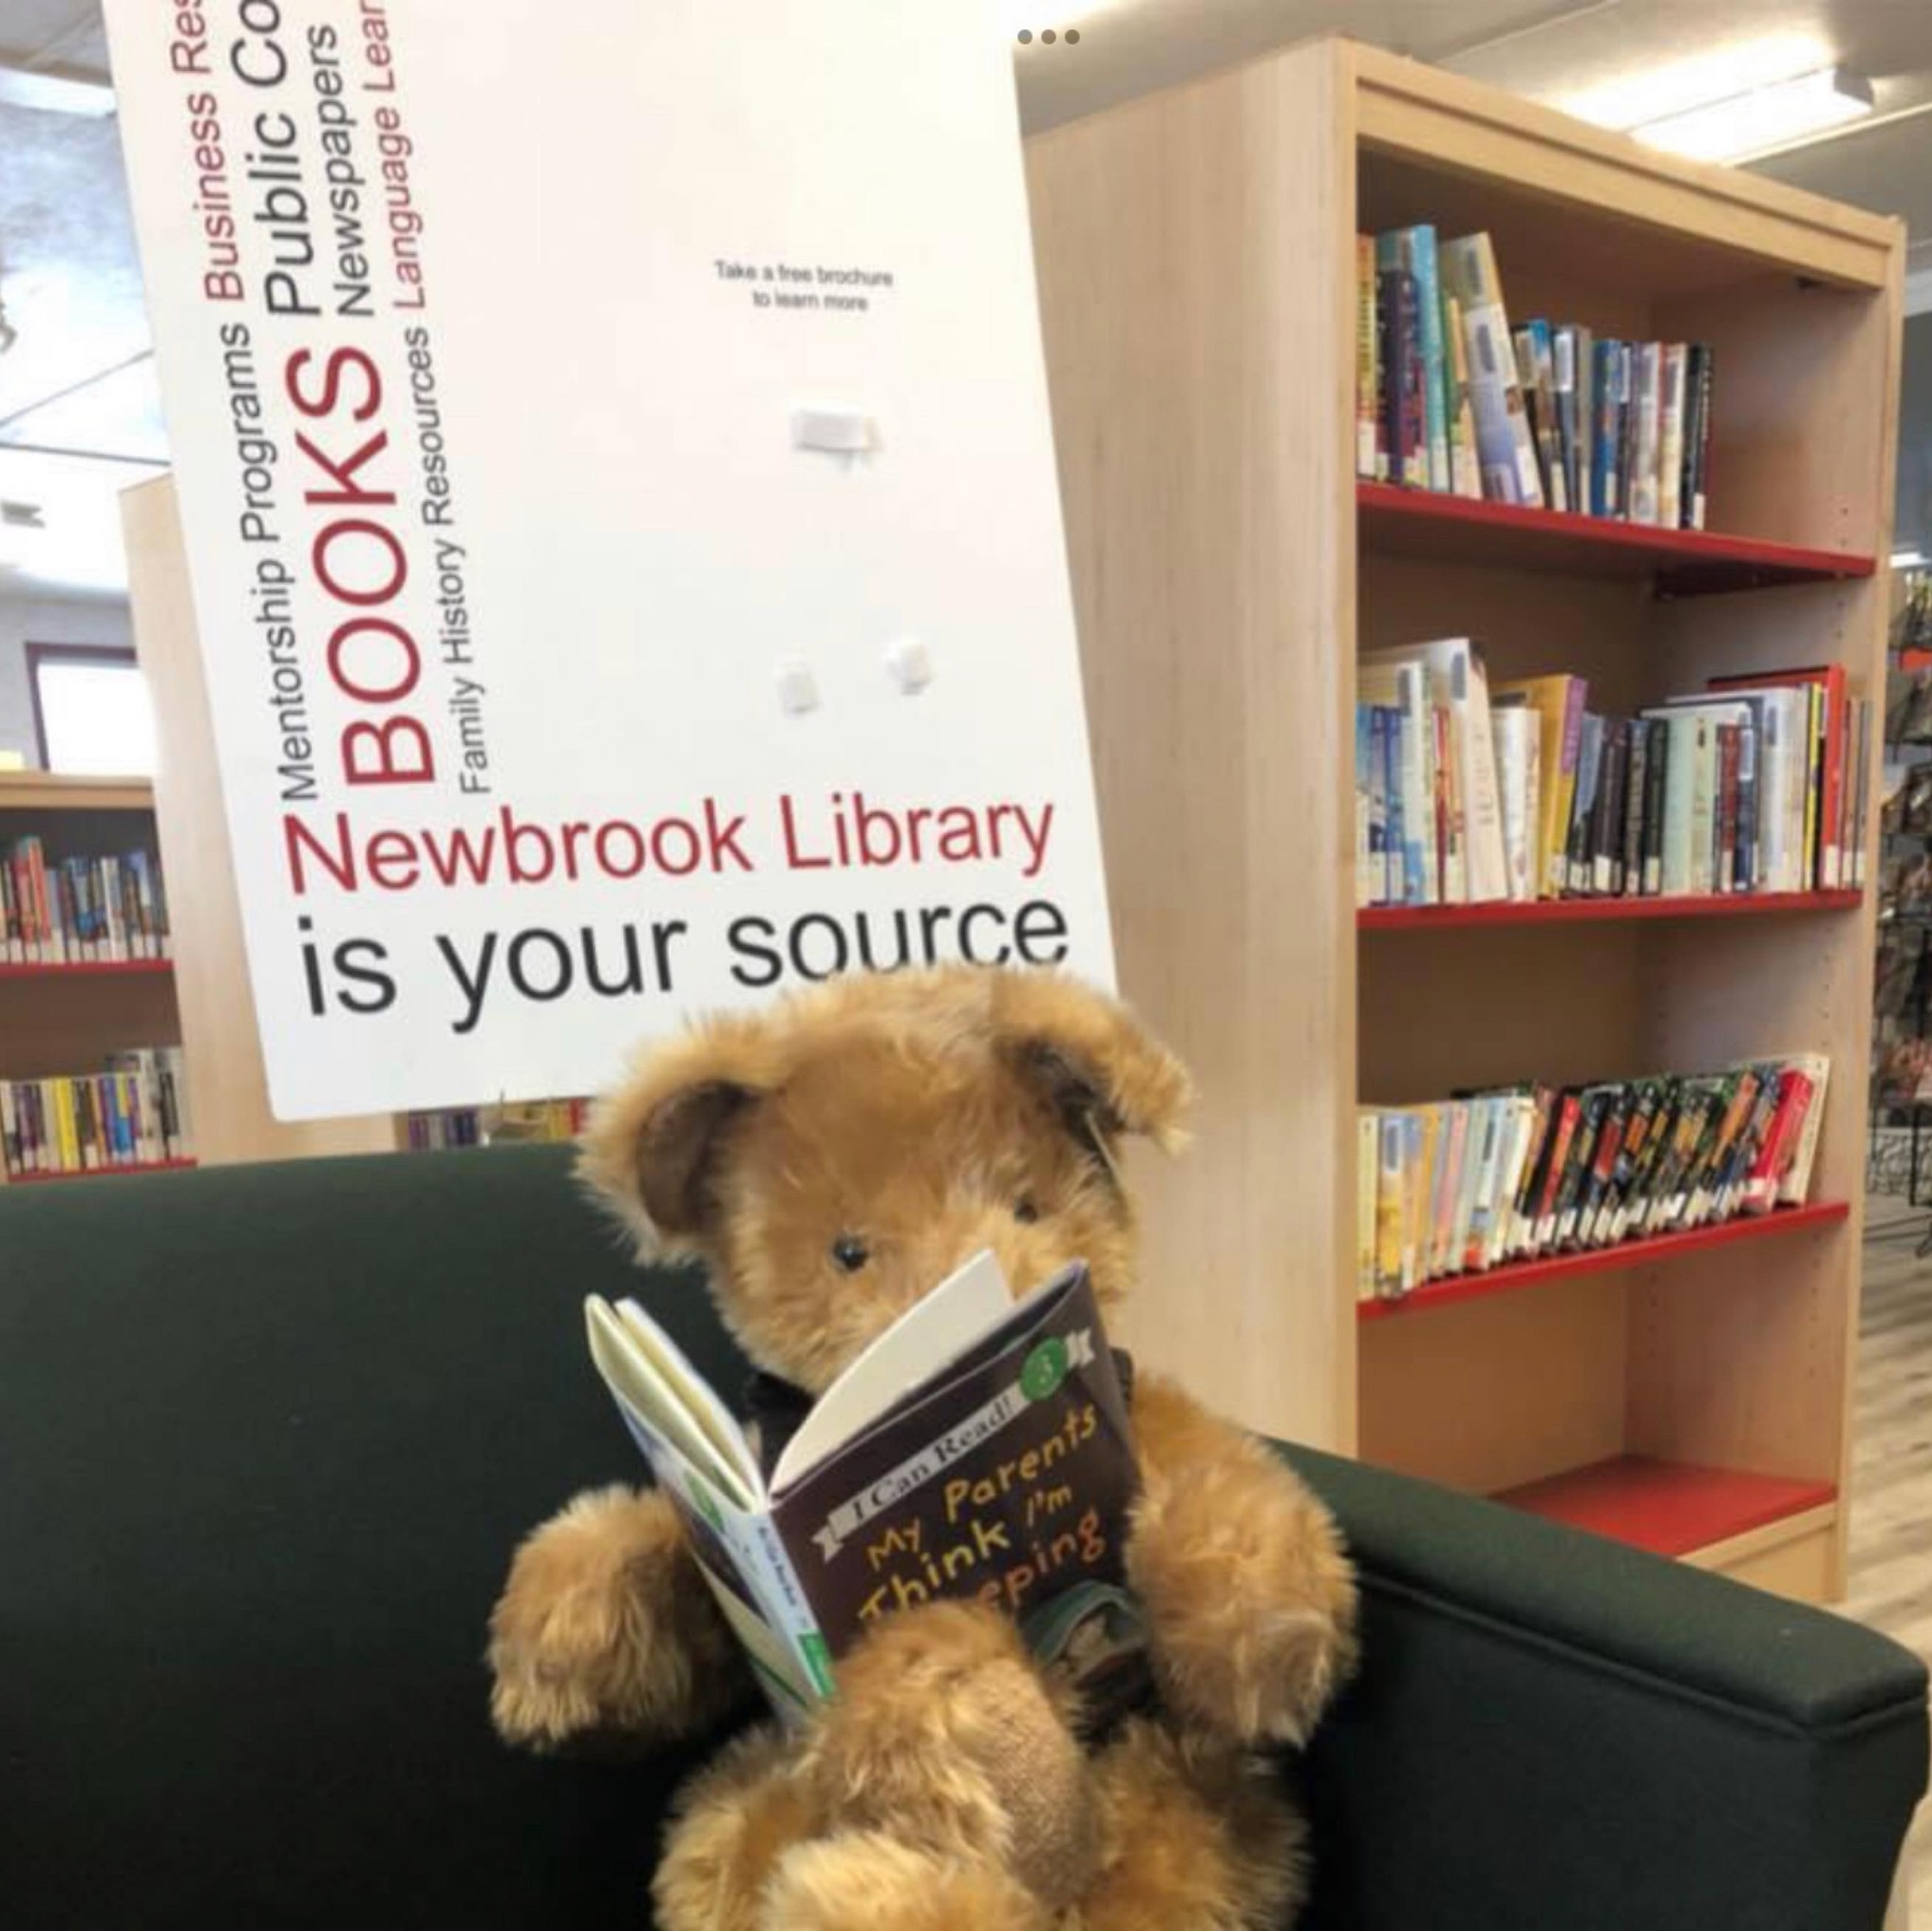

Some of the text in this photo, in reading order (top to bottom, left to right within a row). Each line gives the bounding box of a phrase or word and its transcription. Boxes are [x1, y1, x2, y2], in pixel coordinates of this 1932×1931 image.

[186, 92, 245, 302] Business
[243, 111, 323, 318] Public
[306, 24, 375, 318] Newspapers
[358, 0, 426, 309] Language Lear
[715, 259, 893, 287] Take a free brochure
[752, 291, 868, 311] to learn more
[219, 322, 320, 802] Mentorship Programs
[284, 345, 437, 787] BOOKS
[403, 325, 491, 794] Family History Resources
[282, 791, 1055, 896] Newbrook Library
[296, 898, 1070, 1033] is your source
[853, 1394, 1012, 1520] I Can Read!
[944, 1402, 1098, 1524] Parents
[857, 1519, 1011, 1620] Think
[1026, 1485, 1073, 1527] I'm
[977, 1507, 1107, 1608] eping
